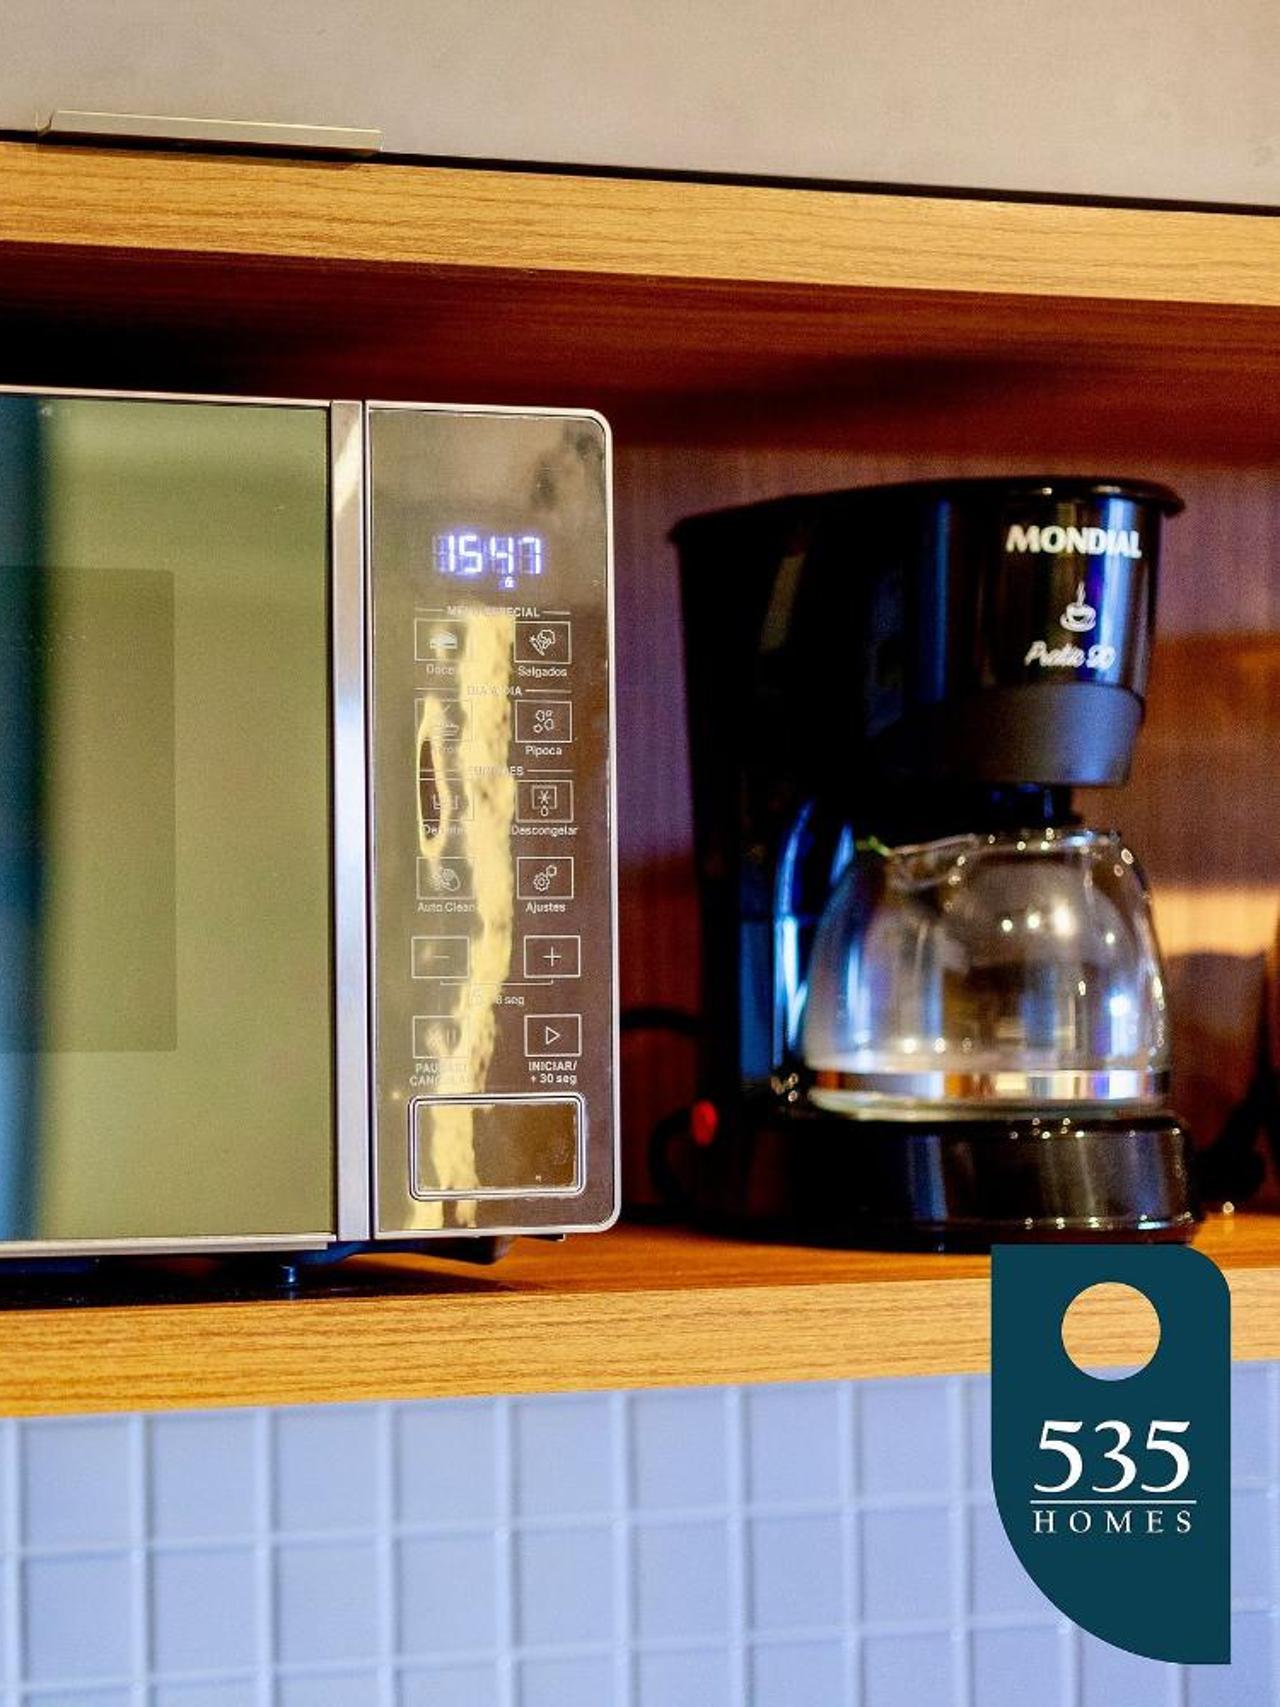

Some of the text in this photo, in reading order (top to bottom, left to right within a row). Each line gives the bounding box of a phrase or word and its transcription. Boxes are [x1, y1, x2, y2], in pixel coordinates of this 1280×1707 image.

[1006, 525, 1142, 558] MONDIAL
[518, 665, 567, 678] Salgados
[525, 745, 562, 756] Pipoca
[511, 825, 578, 838] Descongelar
[418, 902, 442, 913] Auto
[525, 902, 566, 914] Ajustes
[528, 1061, 577, 1071] INICIAR/
[540, 1073, 553, 1084] 30
[556, 1074, 577, 1086] seg
